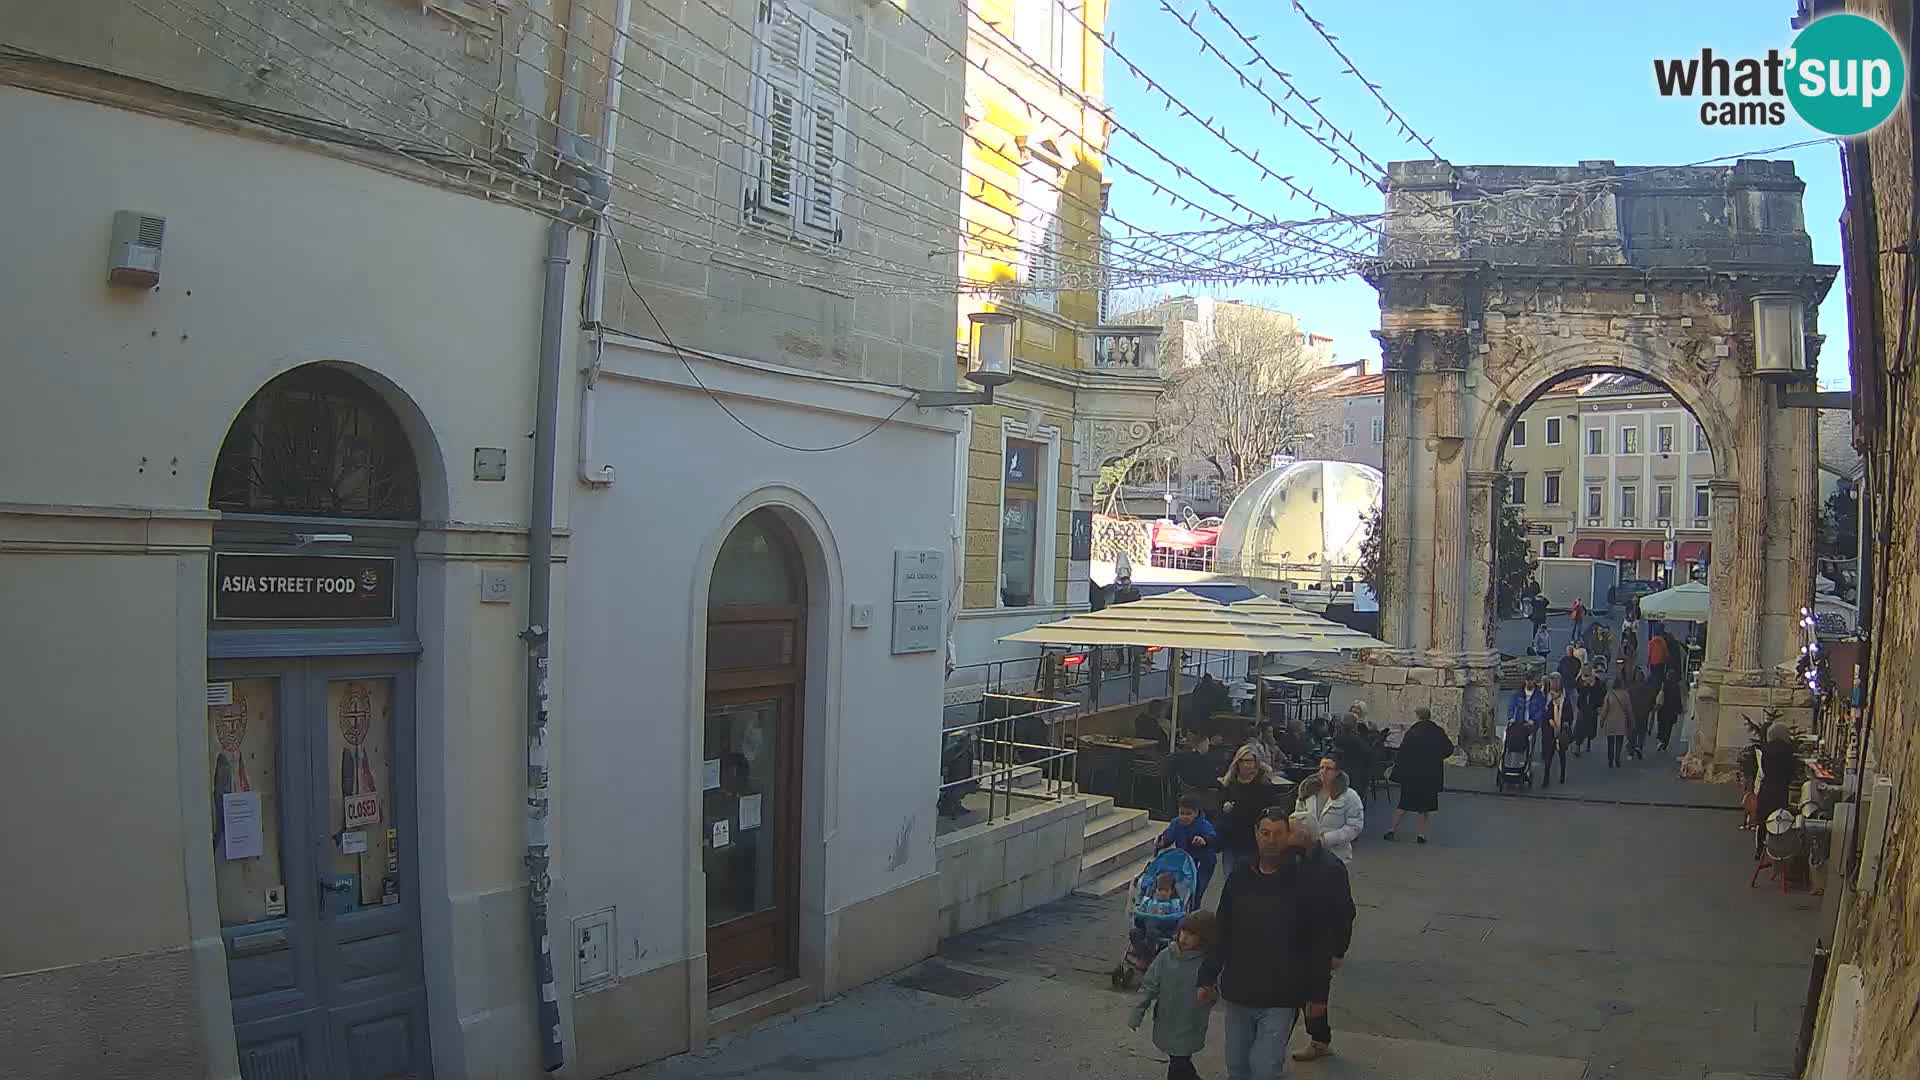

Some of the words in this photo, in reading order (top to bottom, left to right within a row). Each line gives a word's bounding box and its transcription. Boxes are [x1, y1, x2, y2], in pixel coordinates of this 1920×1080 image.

[221, 576, 256, 592] ASIA
[259, 577, 313, 593] STREET
[316, 578, 355, 593] FOOD
[348, 799, 377, 819] CLOSED
